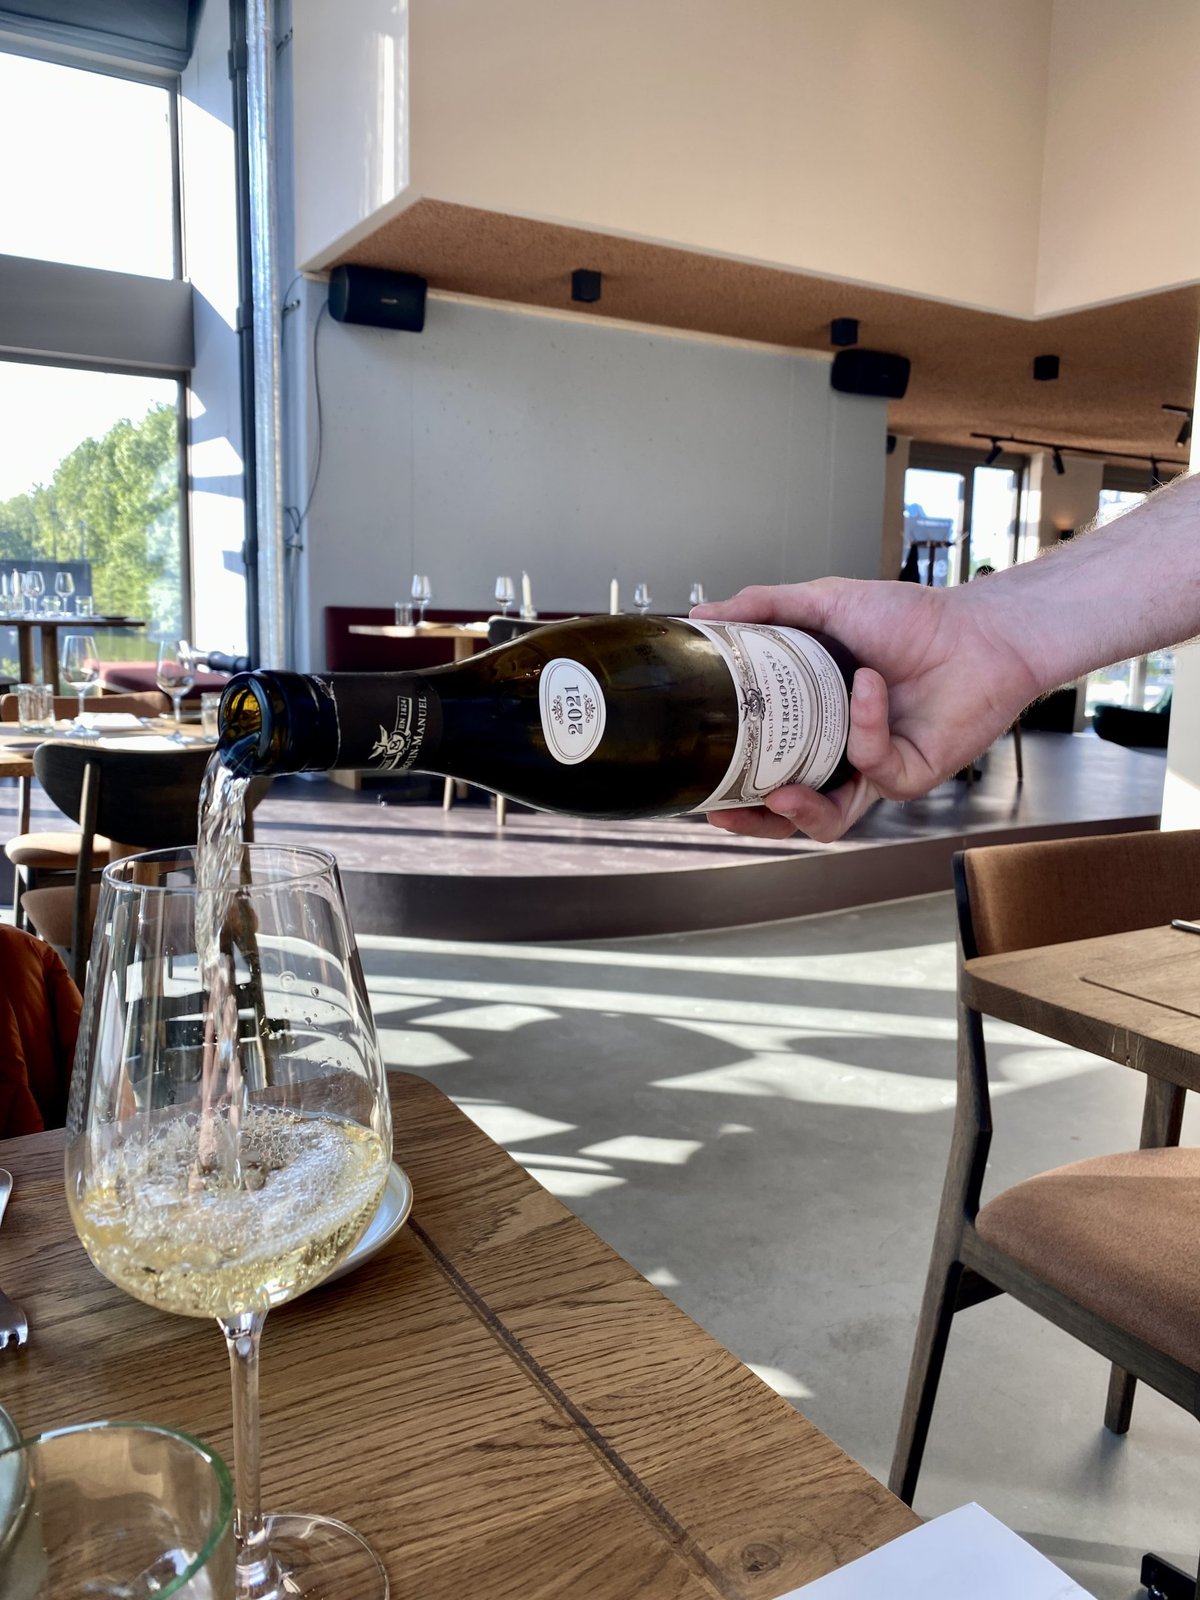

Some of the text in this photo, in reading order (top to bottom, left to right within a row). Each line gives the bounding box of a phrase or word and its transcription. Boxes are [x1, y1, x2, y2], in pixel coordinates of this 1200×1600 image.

[398, 717, 406, 729] EN
[563, 685, 583, 735] 2021
[762, 650, 790, 764] BOURGOGNE
